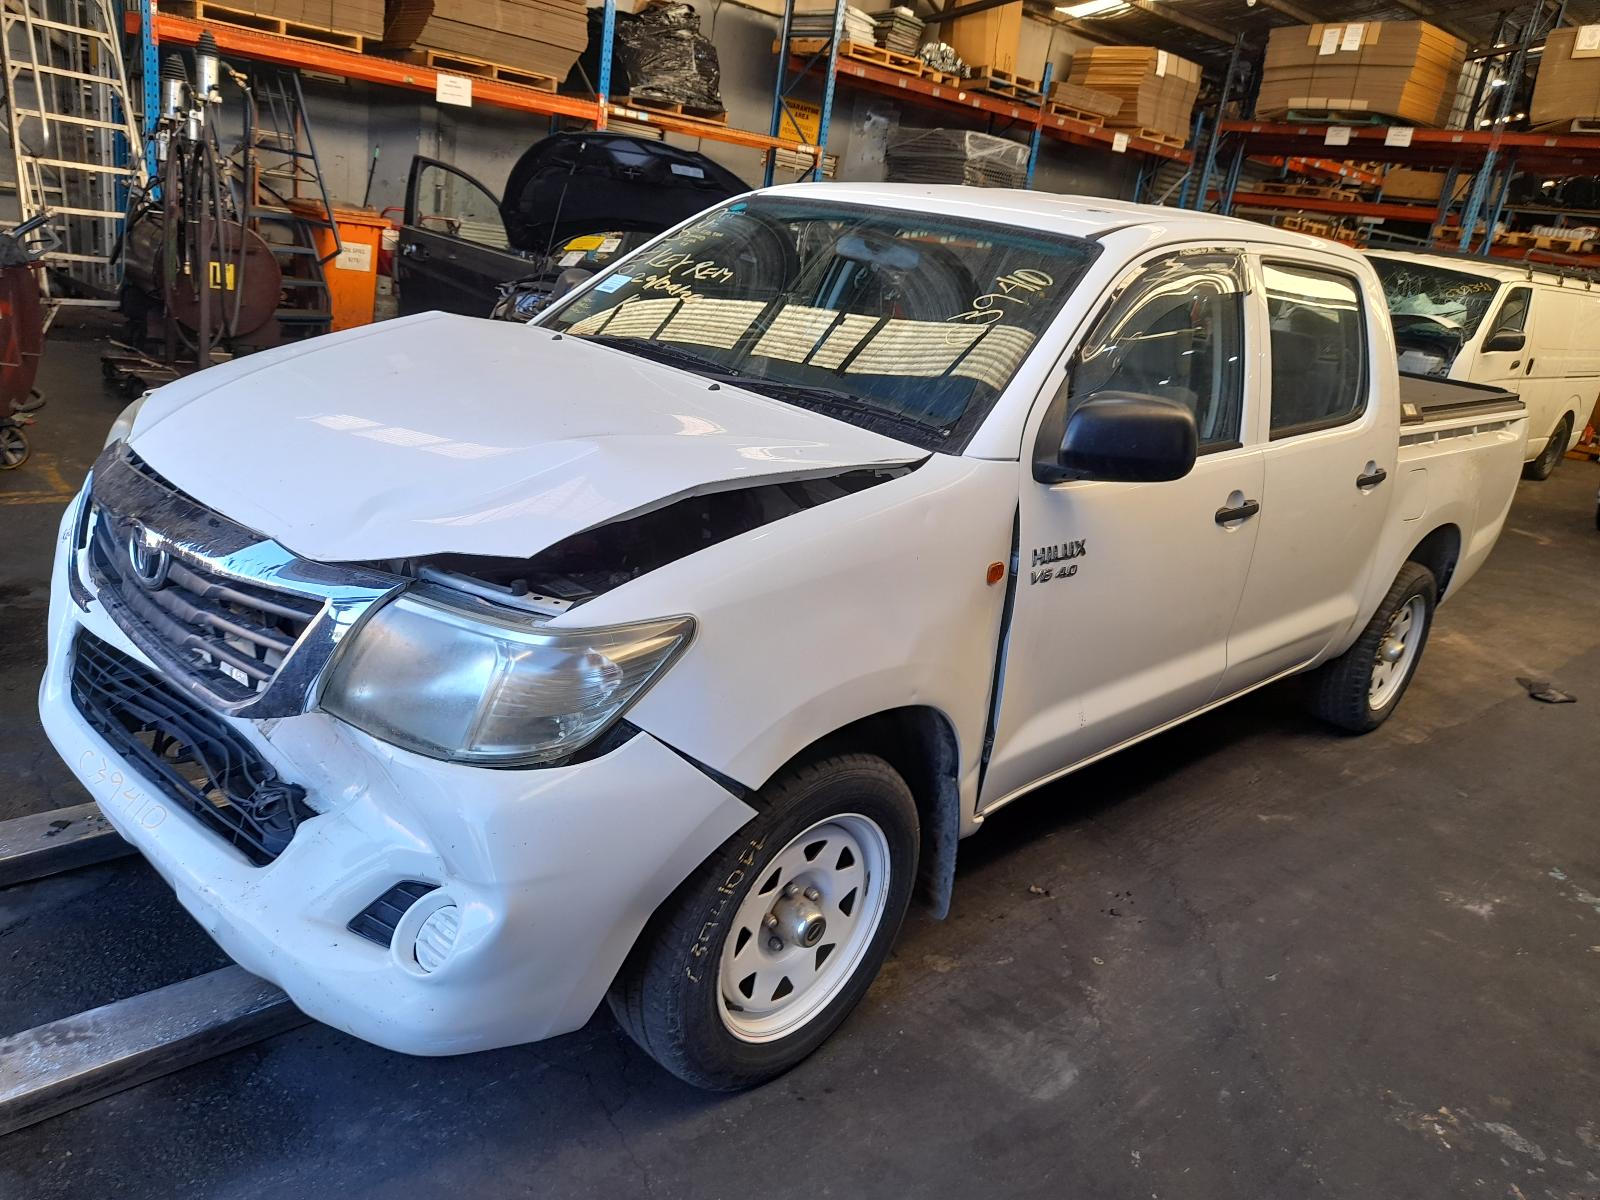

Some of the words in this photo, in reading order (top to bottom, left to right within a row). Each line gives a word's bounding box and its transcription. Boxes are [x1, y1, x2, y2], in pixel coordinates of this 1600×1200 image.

[1032, 537, 1087, 567] HILUX
[1031, 568, 1053, 585] V6
[79, 750, 167, 829] C39410
